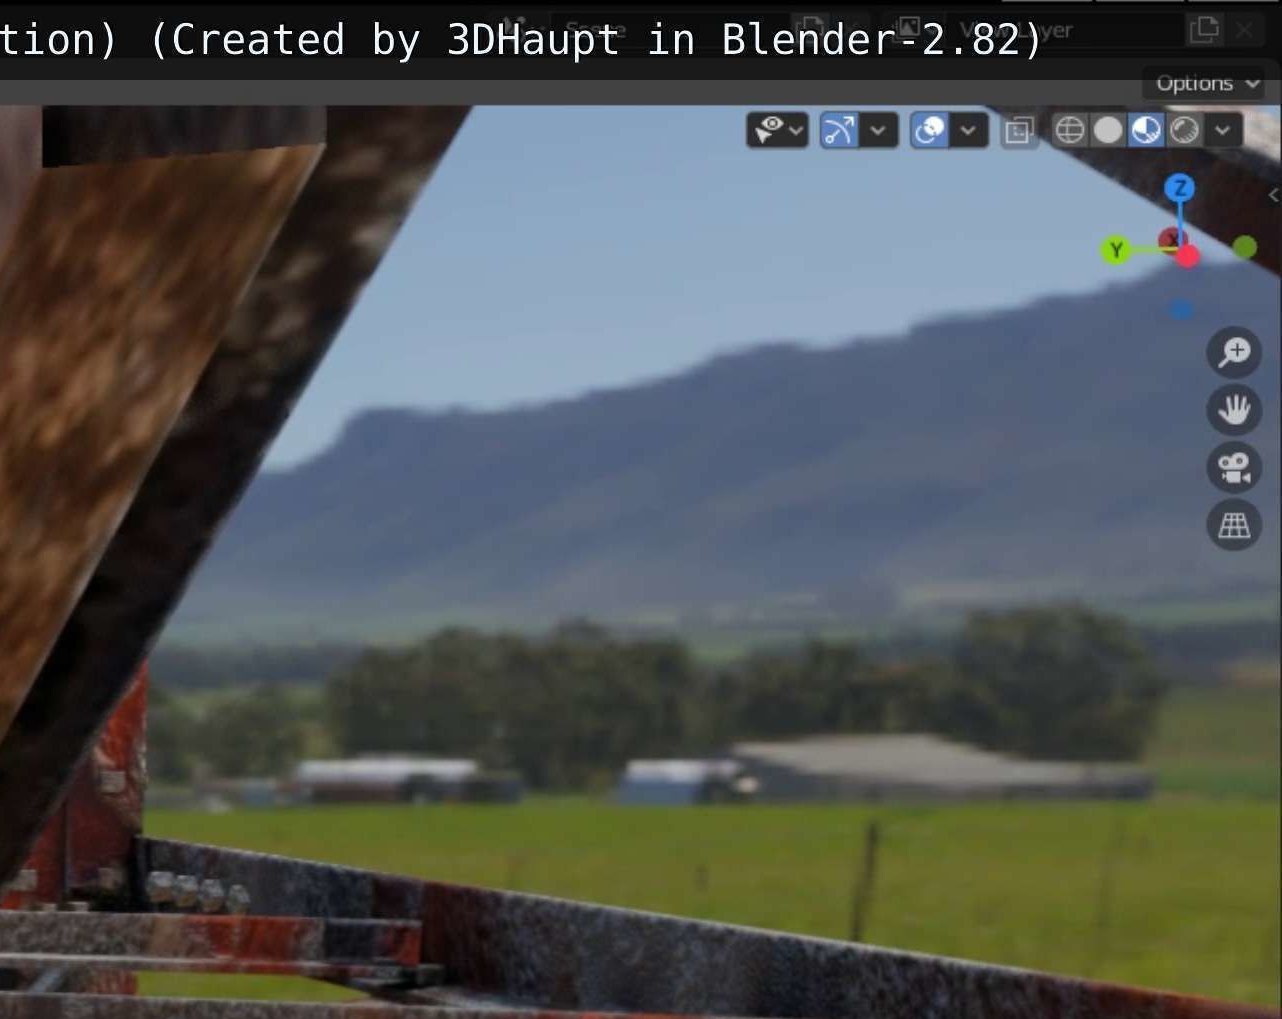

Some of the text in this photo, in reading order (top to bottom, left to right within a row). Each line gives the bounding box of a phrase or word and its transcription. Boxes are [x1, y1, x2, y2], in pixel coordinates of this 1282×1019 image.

[1156, 74, 1234, 96] Options
[1174, 180, 1187, 196] Z
[1110, 241, 1123, 259] Y
